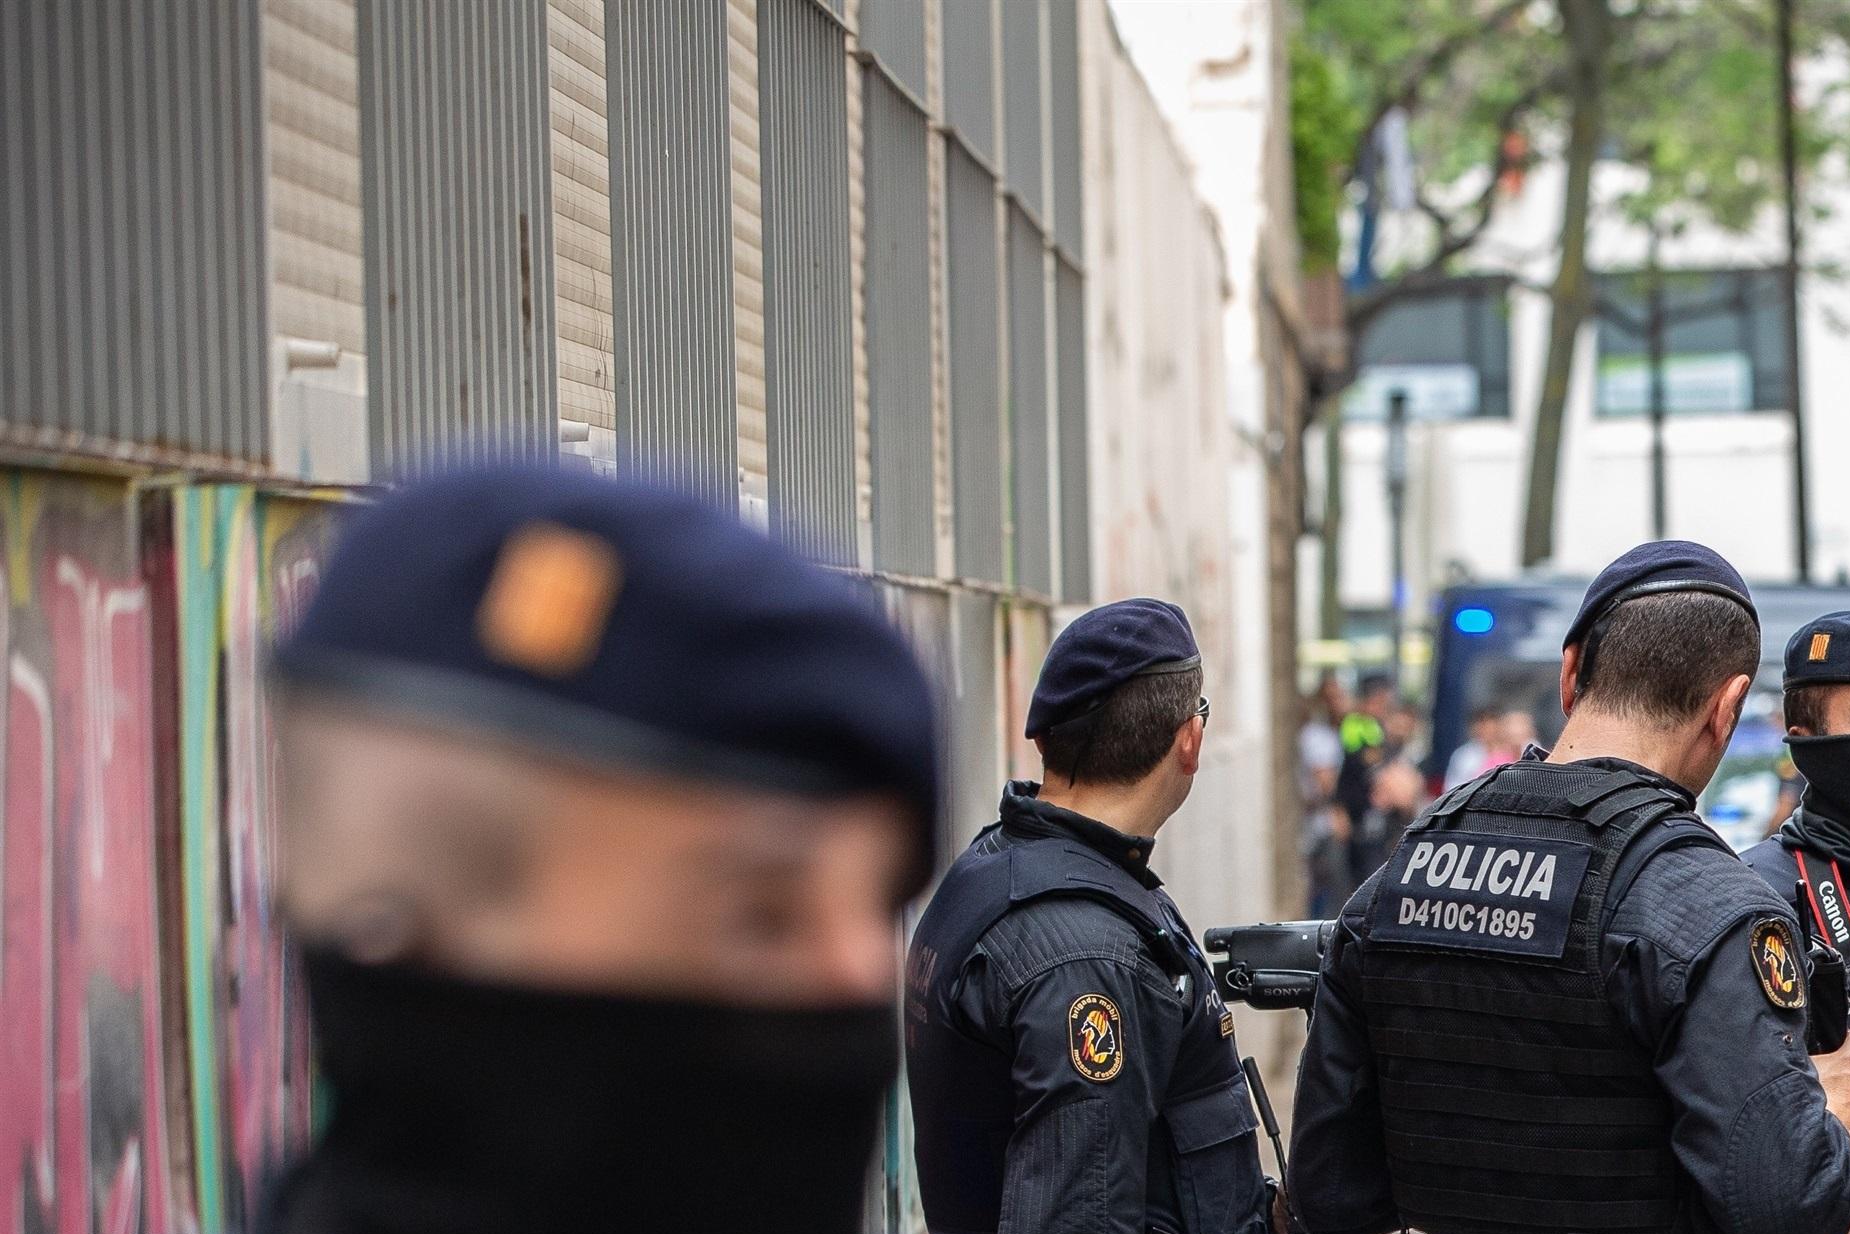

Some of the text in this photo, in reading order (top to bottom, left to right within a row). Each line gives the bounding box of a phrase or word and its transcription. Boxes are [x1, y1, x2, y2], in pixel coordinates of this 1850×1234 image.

[1400, 841, 1557, 901] POLICIA
[1398, 896, 1537, 941] D410C1895
[1818, 880, 1850, 943] Canon
[1071, 996, 1098, 1020] brigada
[1263, 987, 1303, 997] SONY
[1073, 1048, 1093, 1076] mossos
